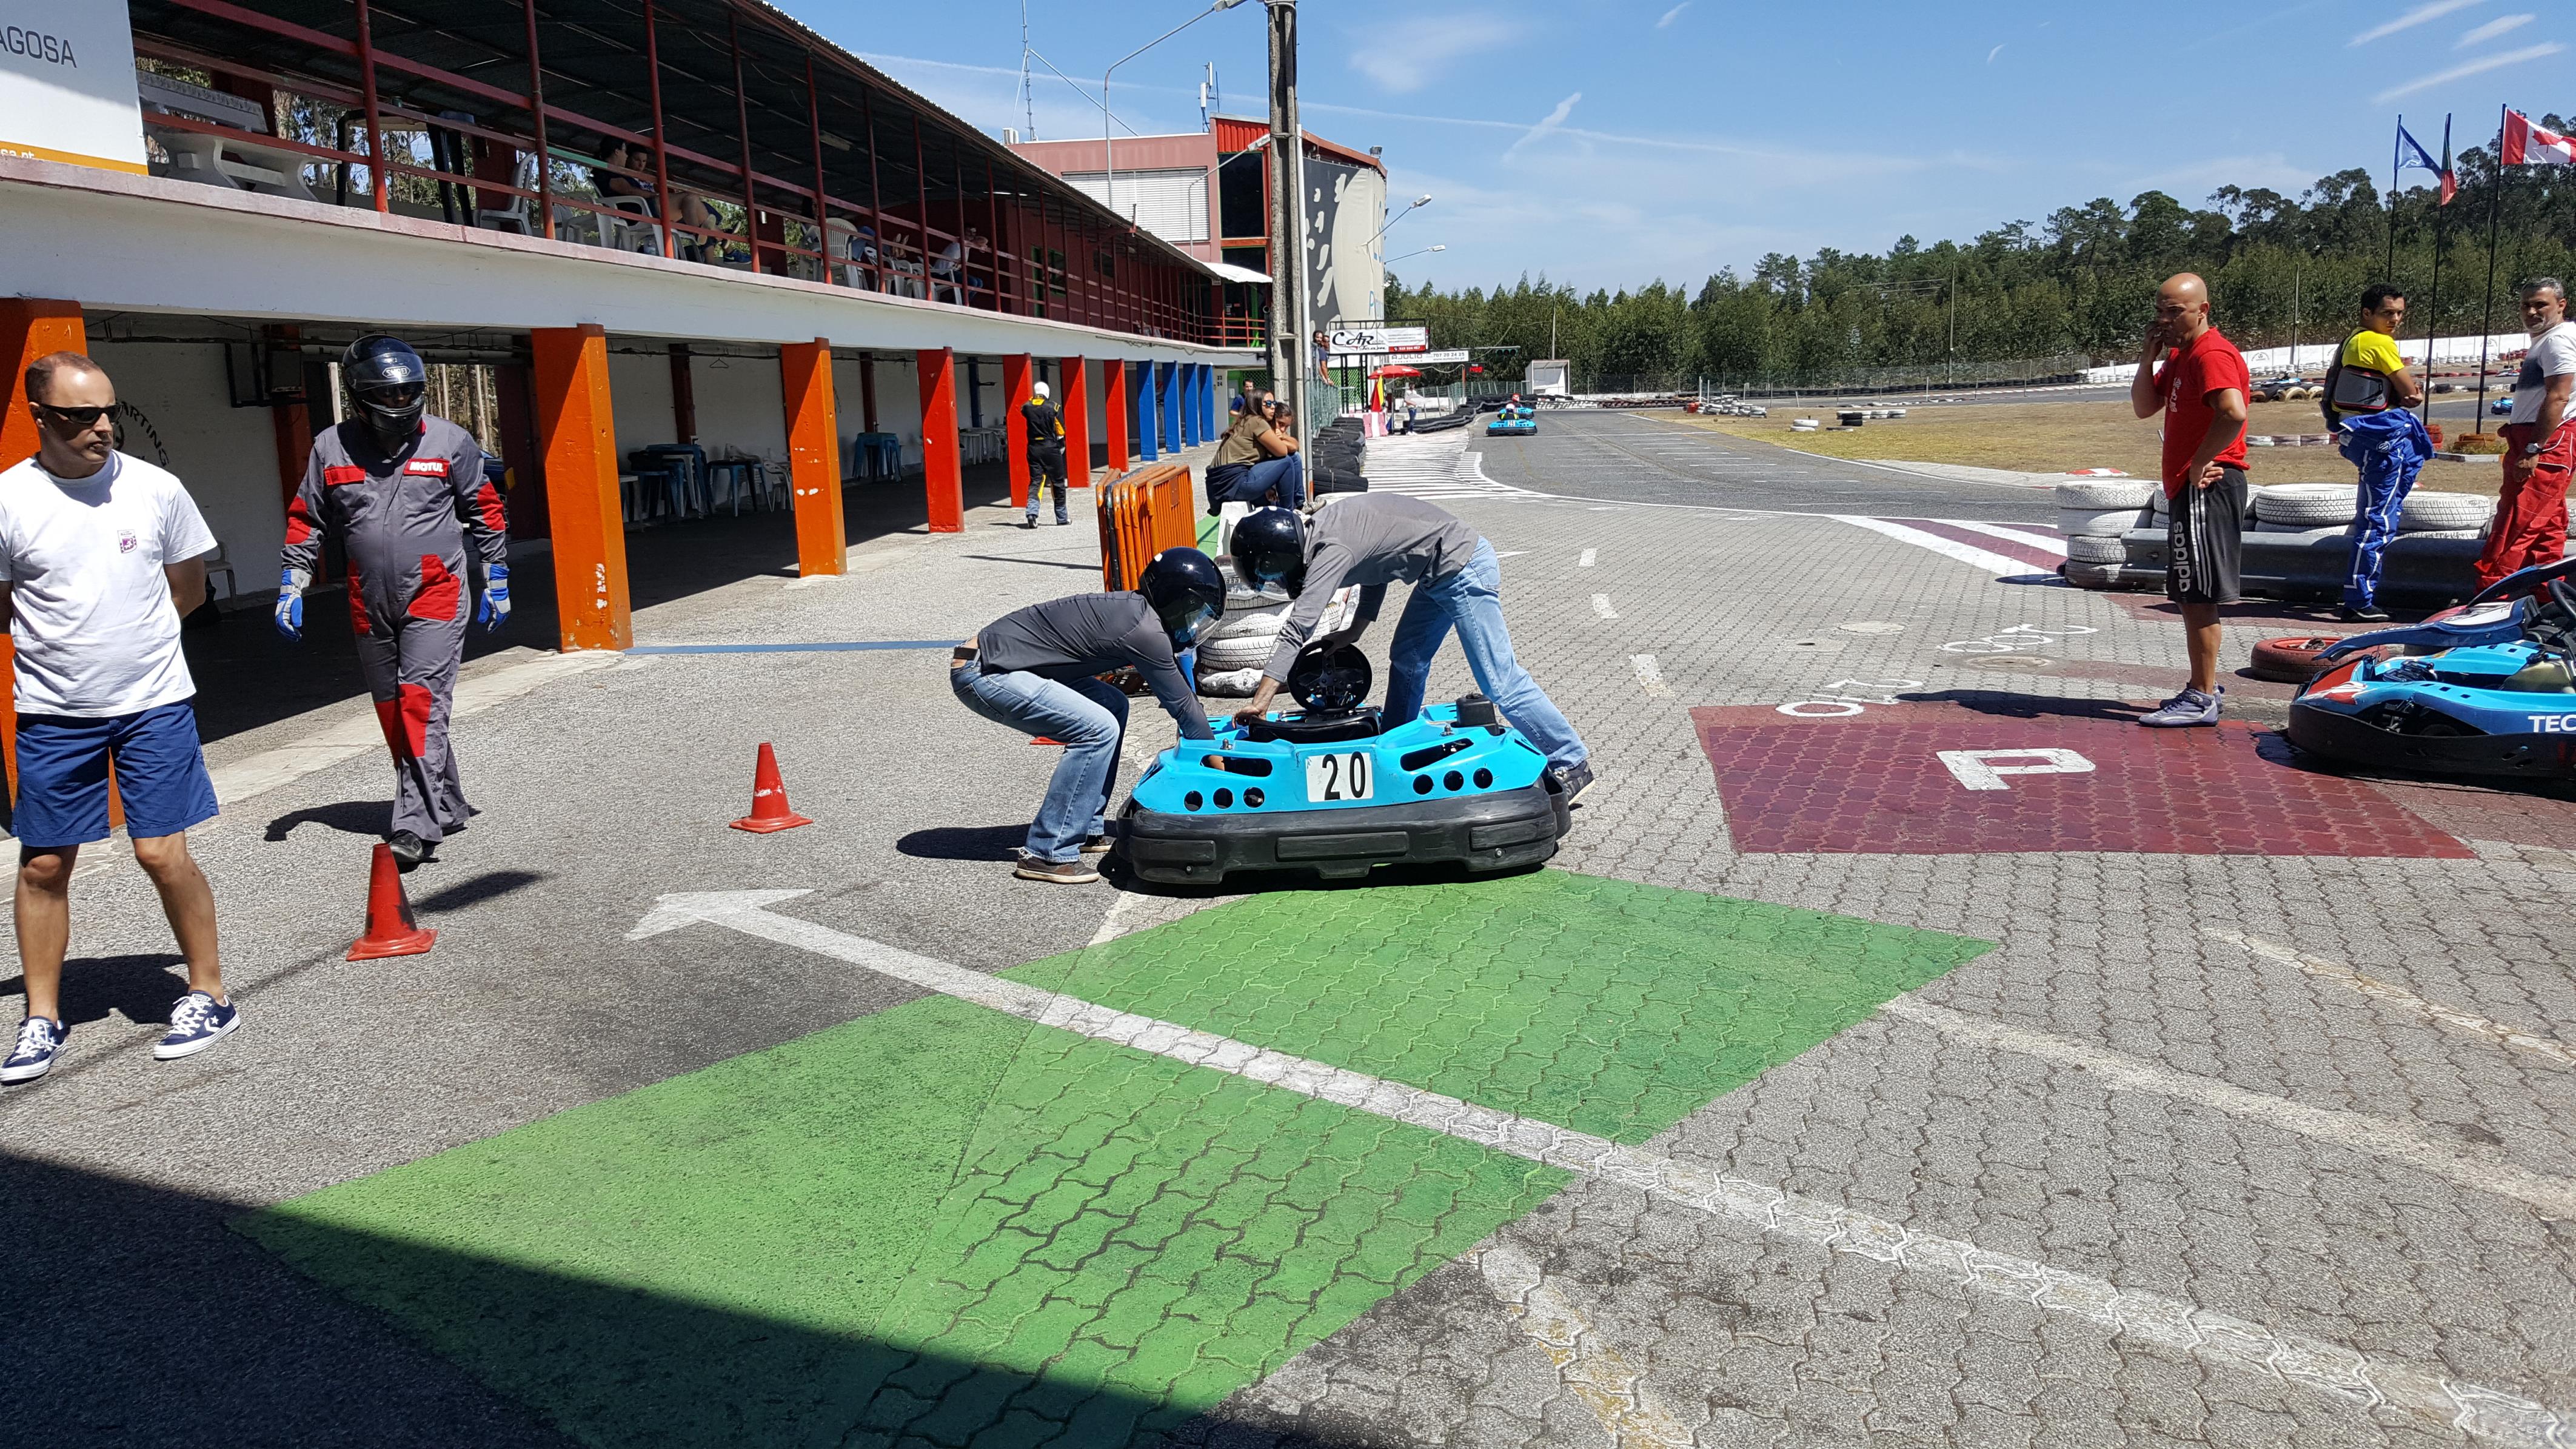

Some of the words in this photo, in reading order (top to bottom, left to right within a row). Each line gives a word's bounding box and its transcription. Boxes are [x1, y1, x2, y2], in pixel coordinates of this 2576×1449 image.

[409, 462, 443, 472] MOTUL
[2173, 521, 2190, 592] adidas
[2527, 714, 2576, 732] TEC
[1322, 751, 1365, 800] 20
[1936, 748, 2096, 790] P
